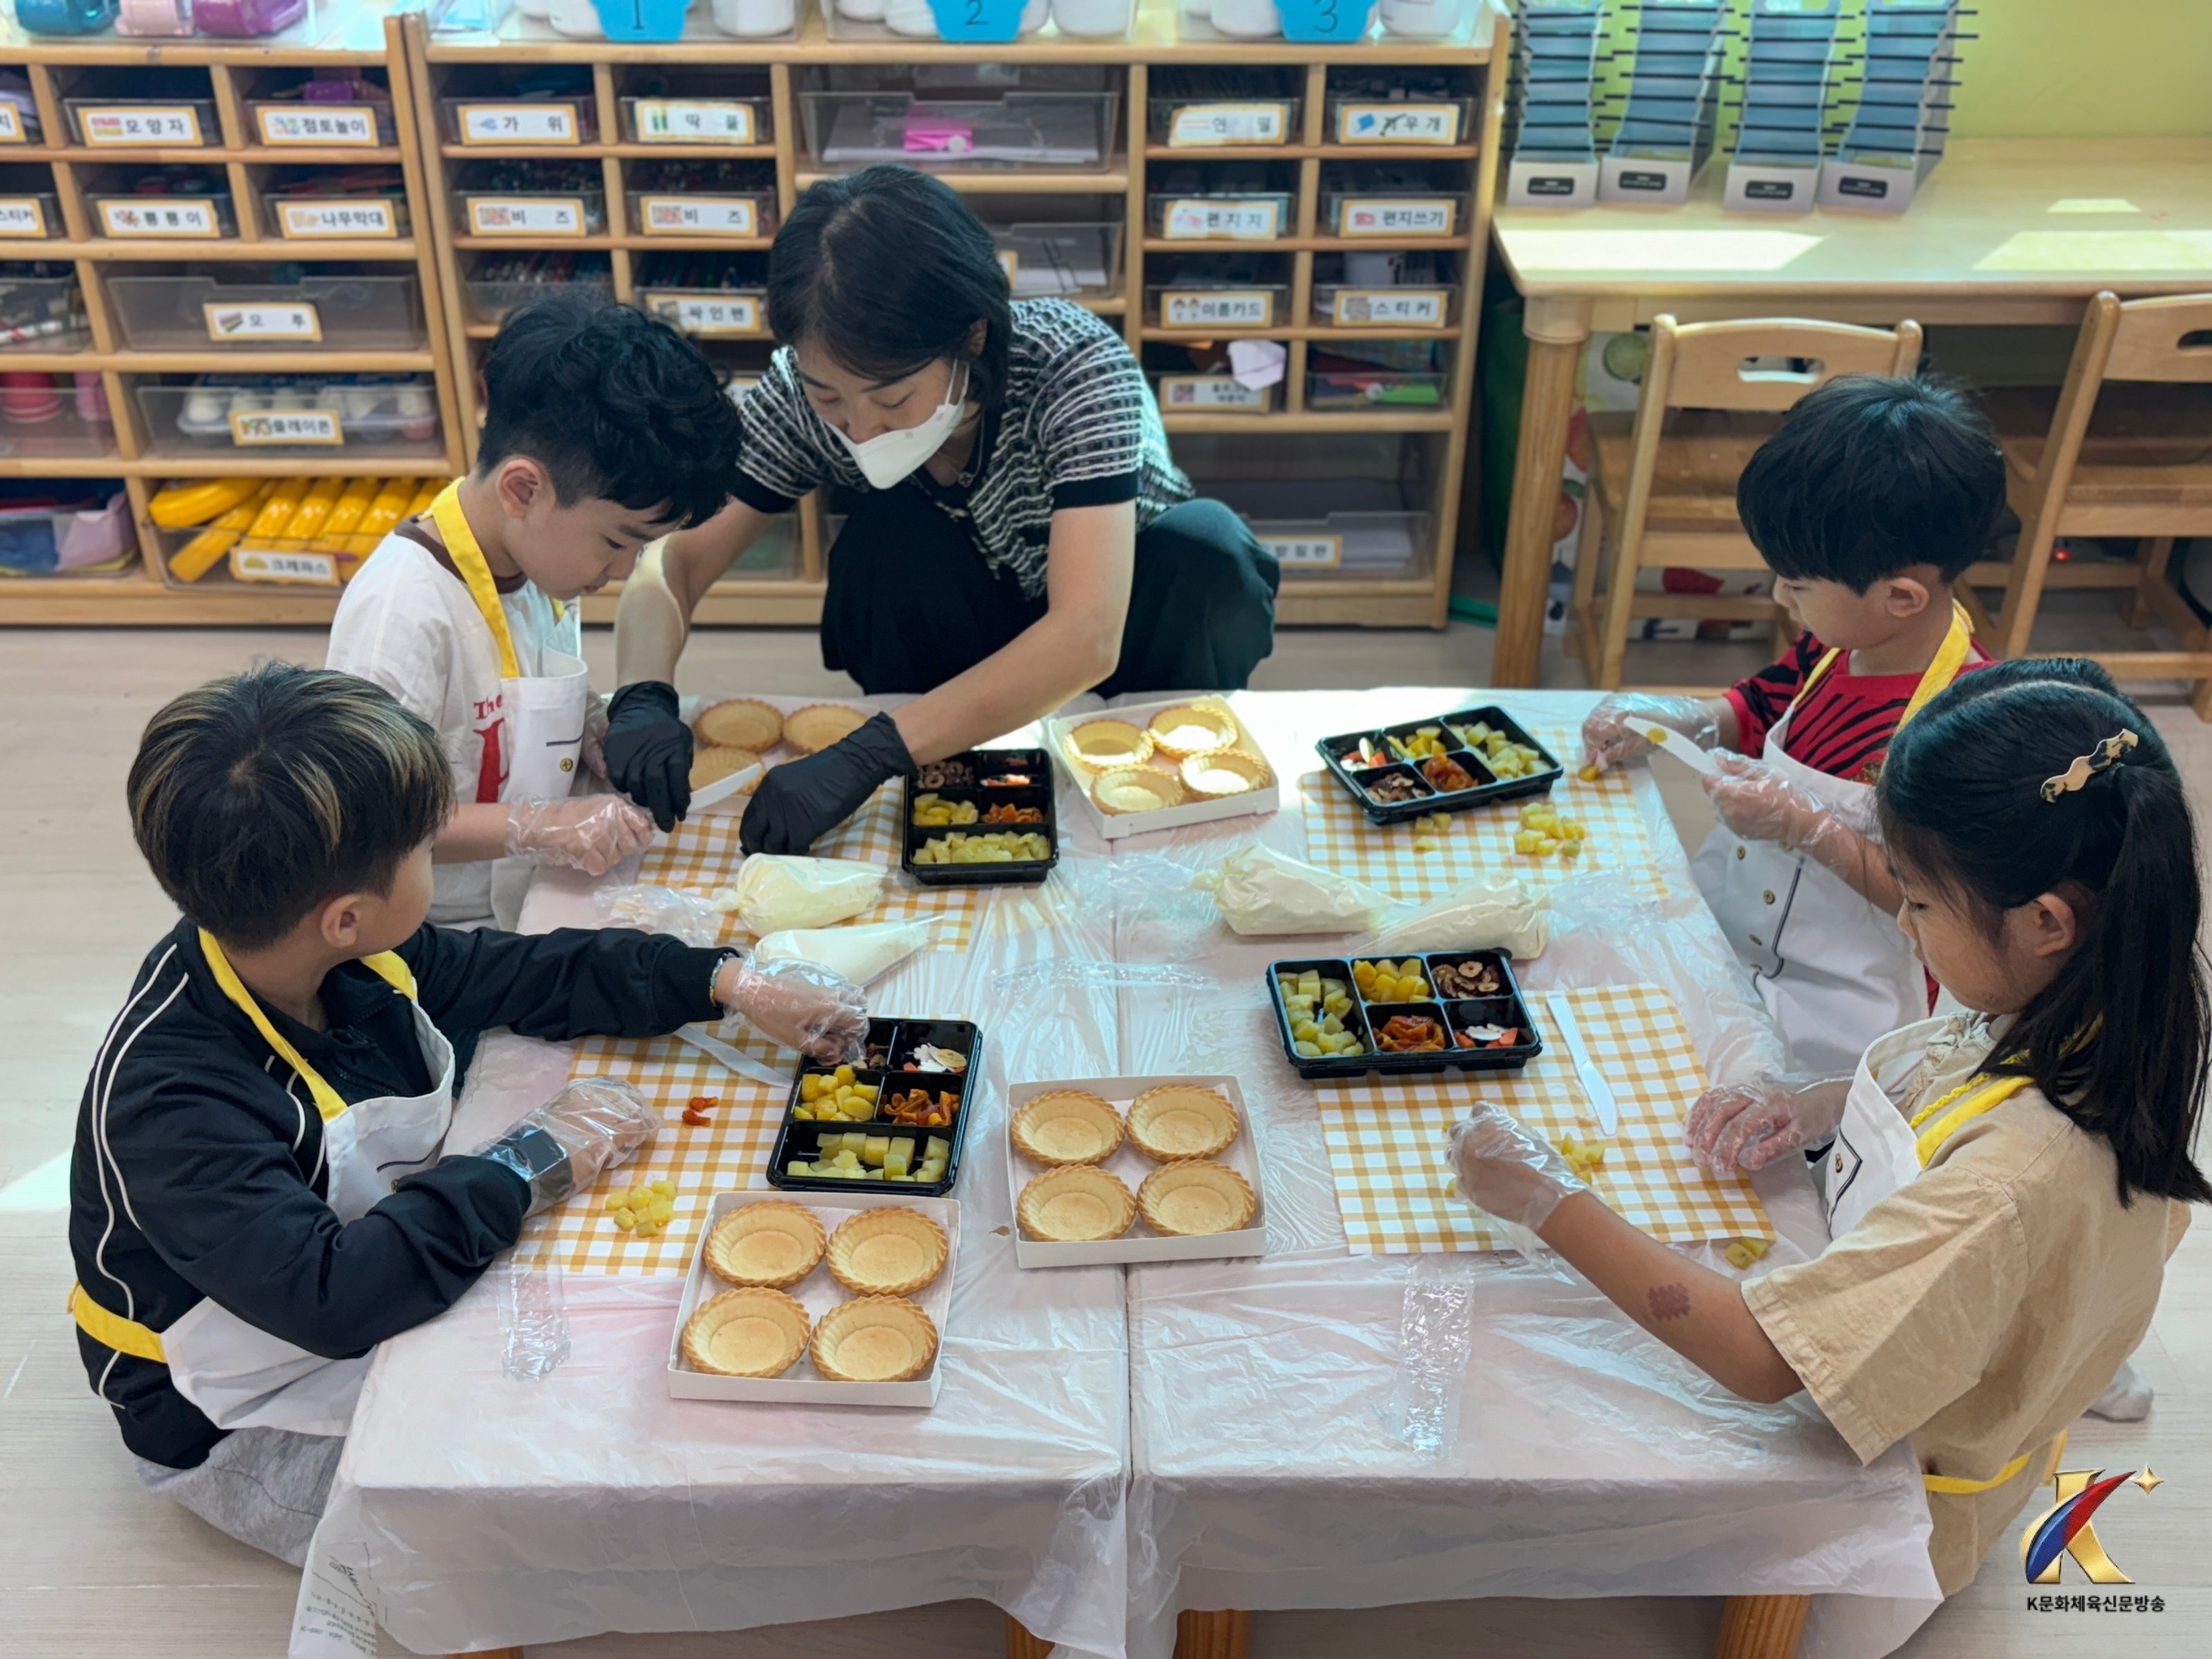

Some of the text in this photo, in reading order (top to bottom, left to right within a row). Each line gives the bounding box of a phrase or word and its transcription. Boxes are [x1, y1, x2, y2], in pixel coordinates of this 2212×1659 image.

[965, 0, 988, 26] 2
[1313, 0, 1338, 33] 3
[302, 118, 366, 135] 점토놀이
[321, 211, 384, 227] 나무막대
[1383, 211, 1443, 226] 편지쓰기
[1202, 301, 1262, 317] 이름카드
[473, 694, 503, 720] The
